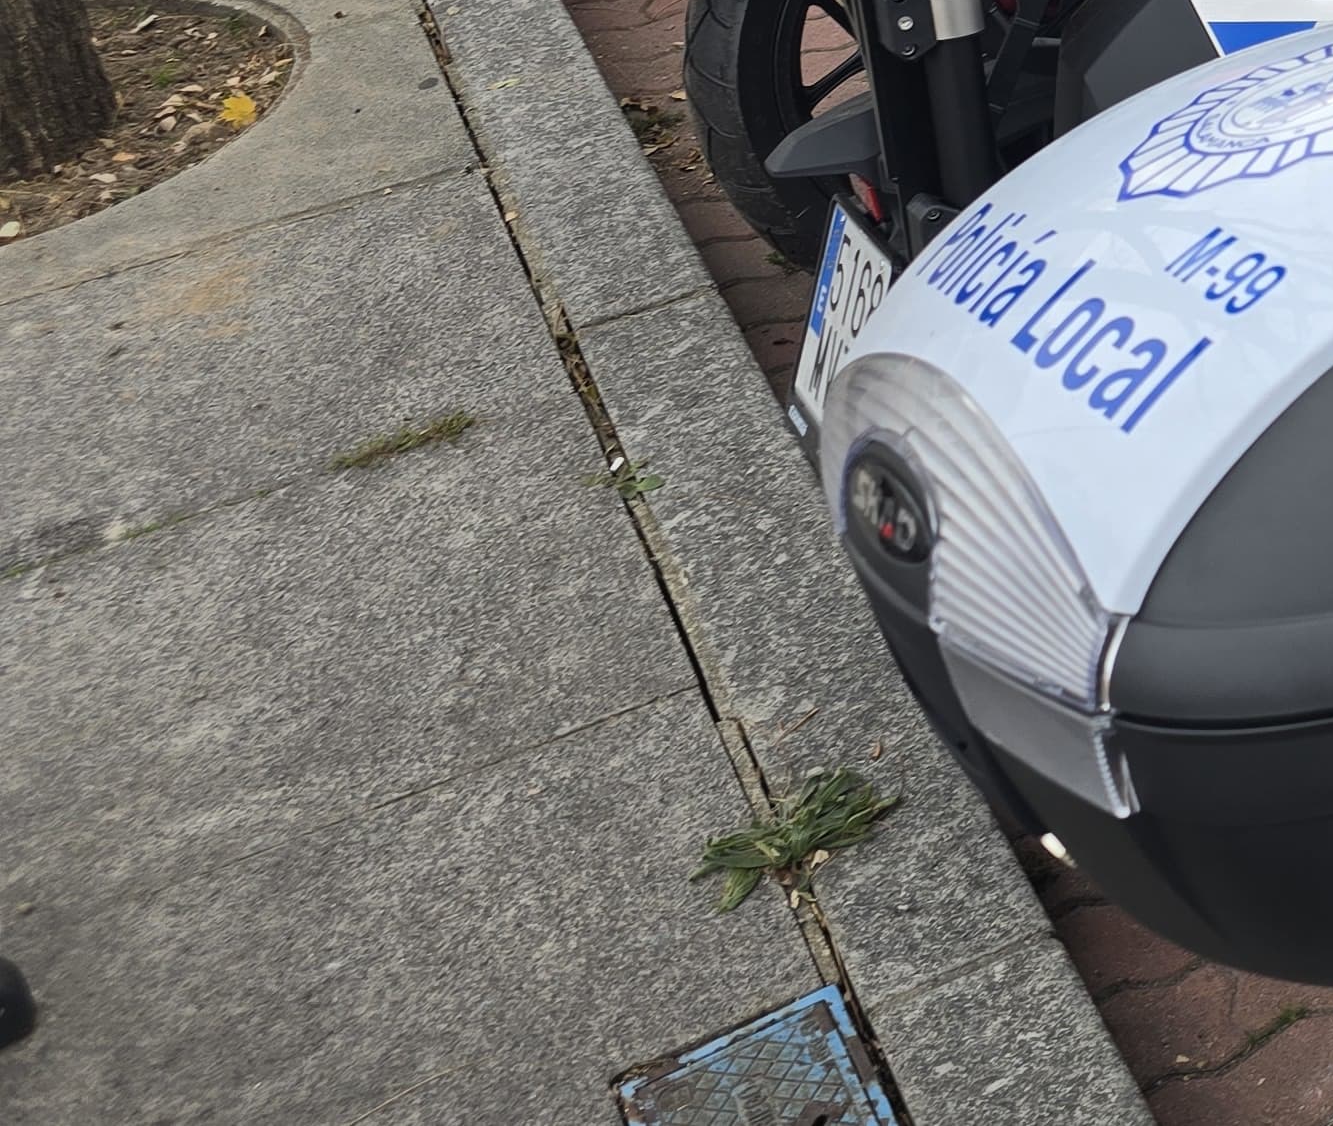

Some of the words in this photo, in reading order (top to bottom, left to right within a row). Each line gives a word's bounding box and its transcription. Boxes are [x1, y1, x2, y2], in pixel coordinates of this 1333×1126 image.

[915, 202, 1058, 329] Policía
[1009, 258, 1213, 434] Local
[1163, 226, 1288, 315] M-99
